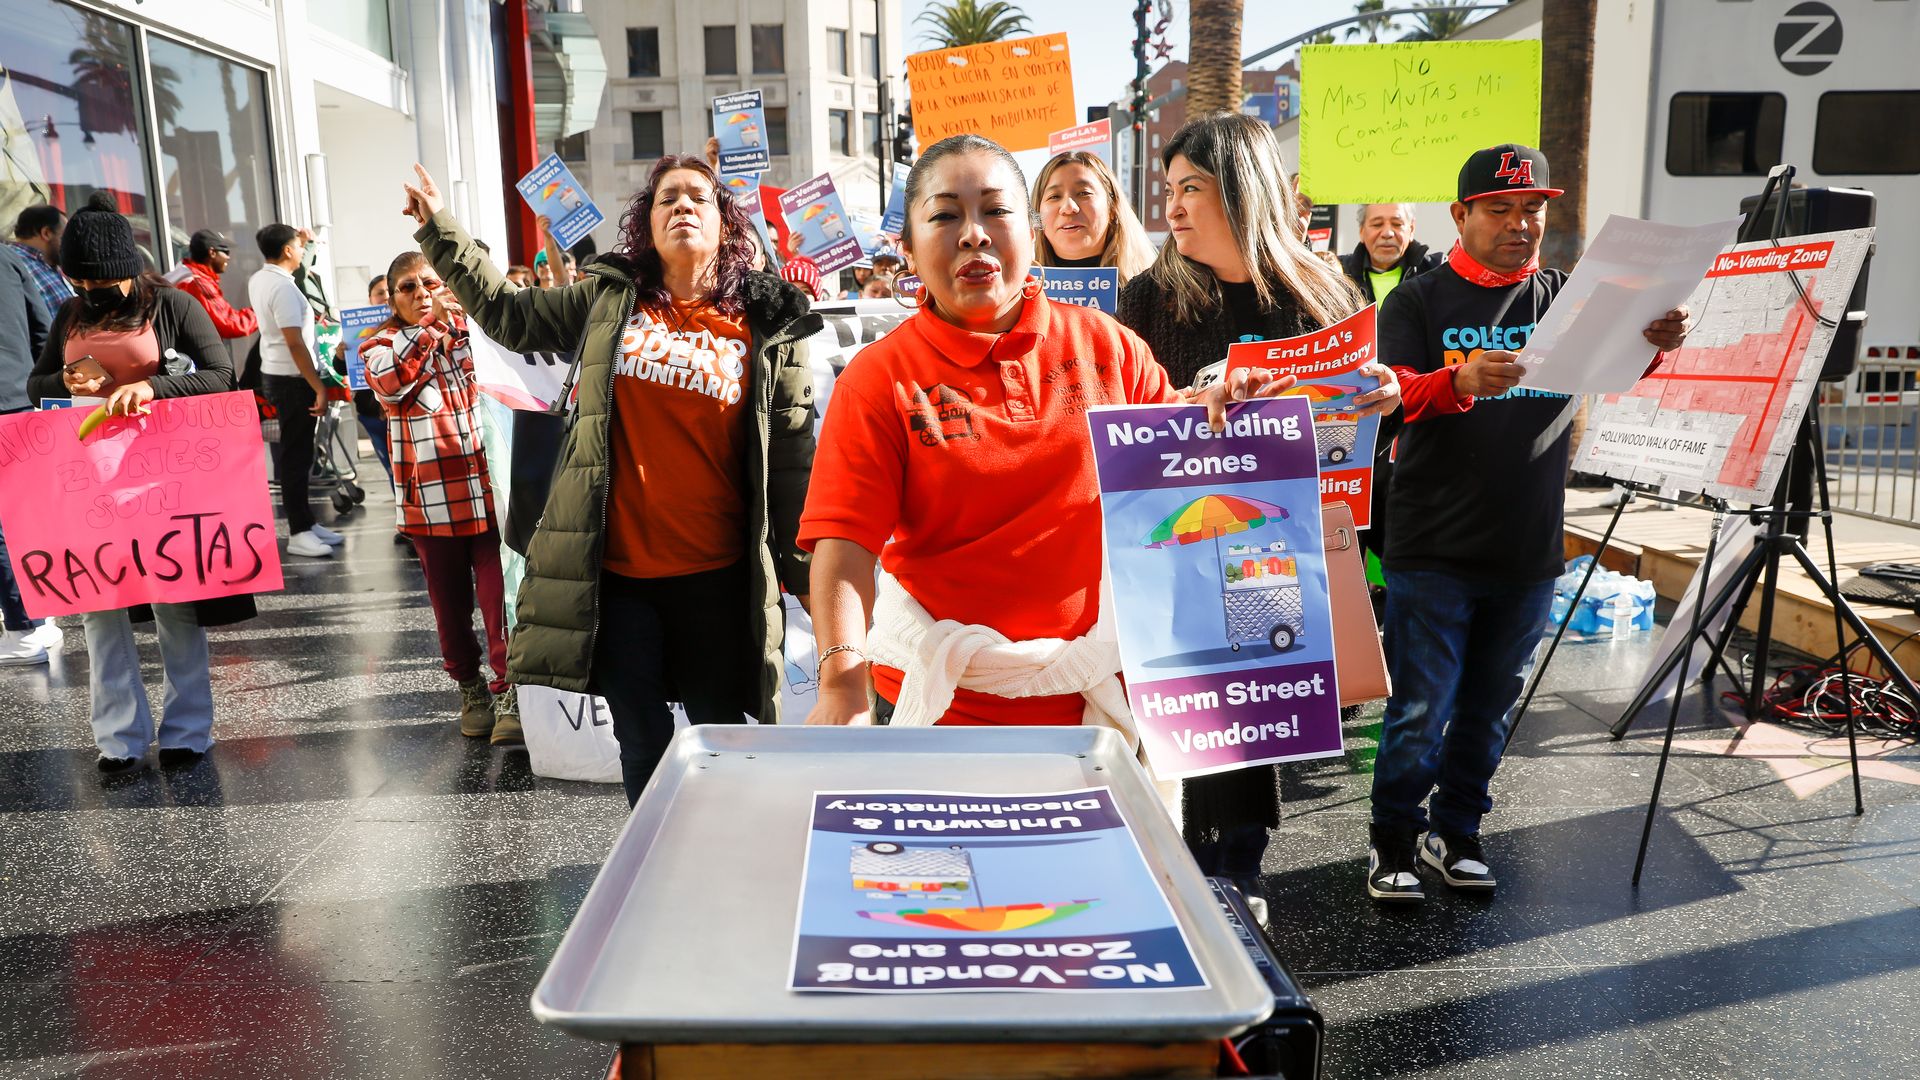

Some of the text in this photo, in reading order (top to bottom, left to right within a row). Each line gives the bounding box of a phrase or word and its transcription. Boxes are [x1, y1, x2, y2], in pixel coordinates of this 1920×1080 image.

[908, 39, 1053, 72] VENDERES UNDOS
[953, 69, 991, 84] LUCHA
[1002, 66, 1018, 81] EN
[1023, 60, 1070, 78] CONTRA
[990, 103, 1059, 129] AMBULANTE
[1494, 151, 1534, 185] LA
[1717, 250, 1790, 271] No-Vending
[1791, 248, 1828, 264] Zone
[1042, 277, 1111, 291] onas de
[627, 312, 746, 357] OLECTIVO
[1266, 331, 1353, 360] End LA's
[620, 330, 716, 374] ODER
[1243, 342, 1371, 376] criminatory
[1600, 430, 1708, 455] HOLLYWOOD WALK OF FAME
[57, 437, 221, 492] ZONES
[1160, 452, 1257, 478] Zones
[1320, 477, 1362, 494] ding
[85, 481, 182, 528] SON
[21, 512, 265, 605] RACISTAS
[1140, 673, 1325, 718] Harm Street
[1172, 715, 1300, 753] Vendors!
[826, 798, 1101, 815] Discriminatory
[852, 816, 1083, 832] Unlawful &
[849, 940, 1136, 960] Zones are
[817, 962, 1176, 985] No-Vending
